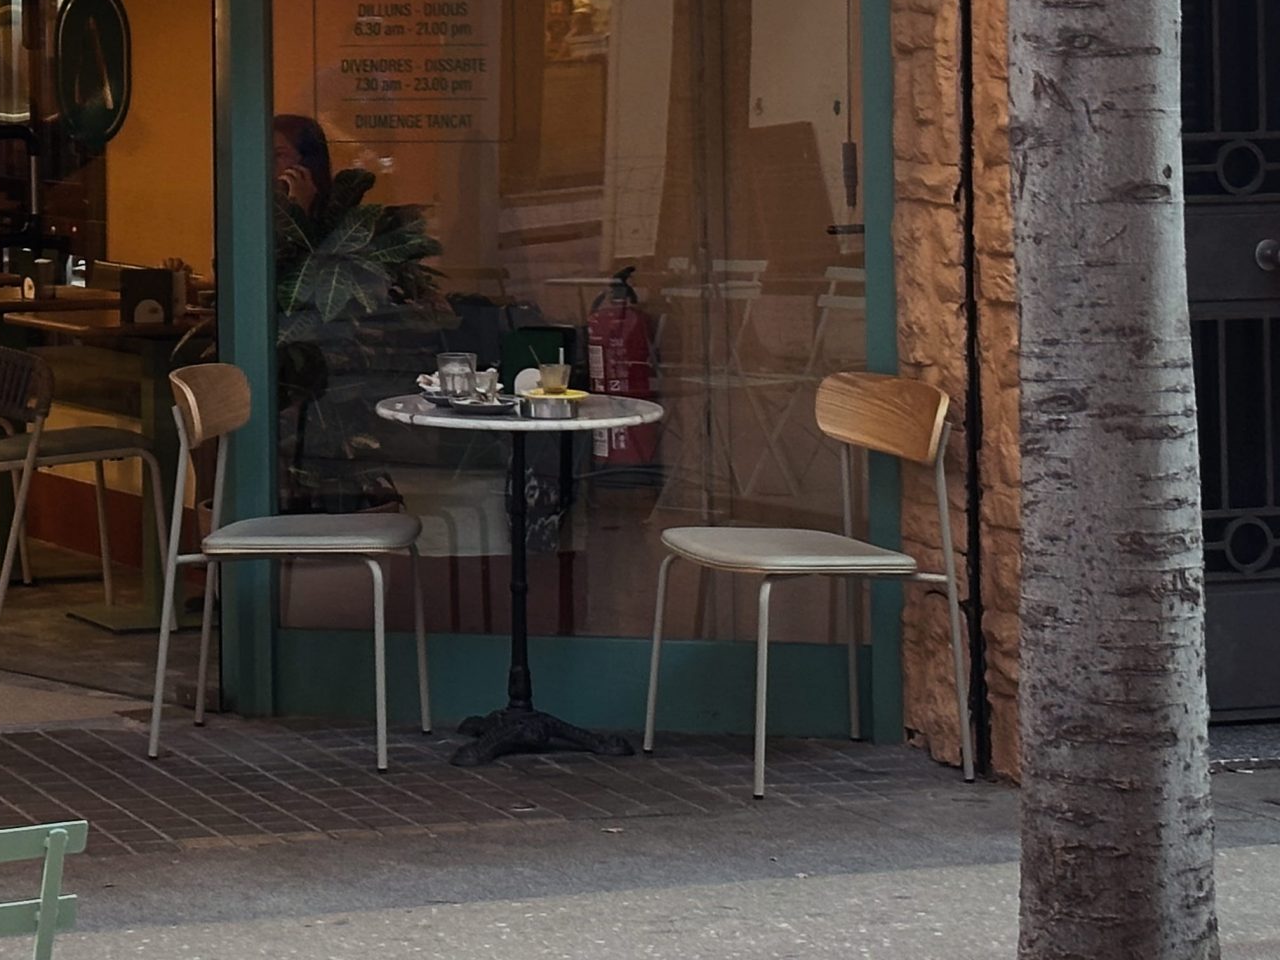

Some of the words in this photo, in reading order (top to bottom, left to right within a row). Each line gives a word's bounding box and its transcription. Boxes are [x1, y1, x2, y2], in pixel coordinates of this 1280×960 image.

[358, 3, 411, 17] DILLUNS
[383, 24, 405, 35] am
[416, 22, 449, 36] 21.00
[451, 24, 472, 38] pm
[341, 59, 413, 73] DIVENDRES
[424, 58, 487, 73] DISSABTE
[414, 77, 448, 91] 23.00
[451, 80, 472, 94] pm
[355, 115, 423, 129] DIUMENGE
[427, 114, 473, 129] TANCAT
